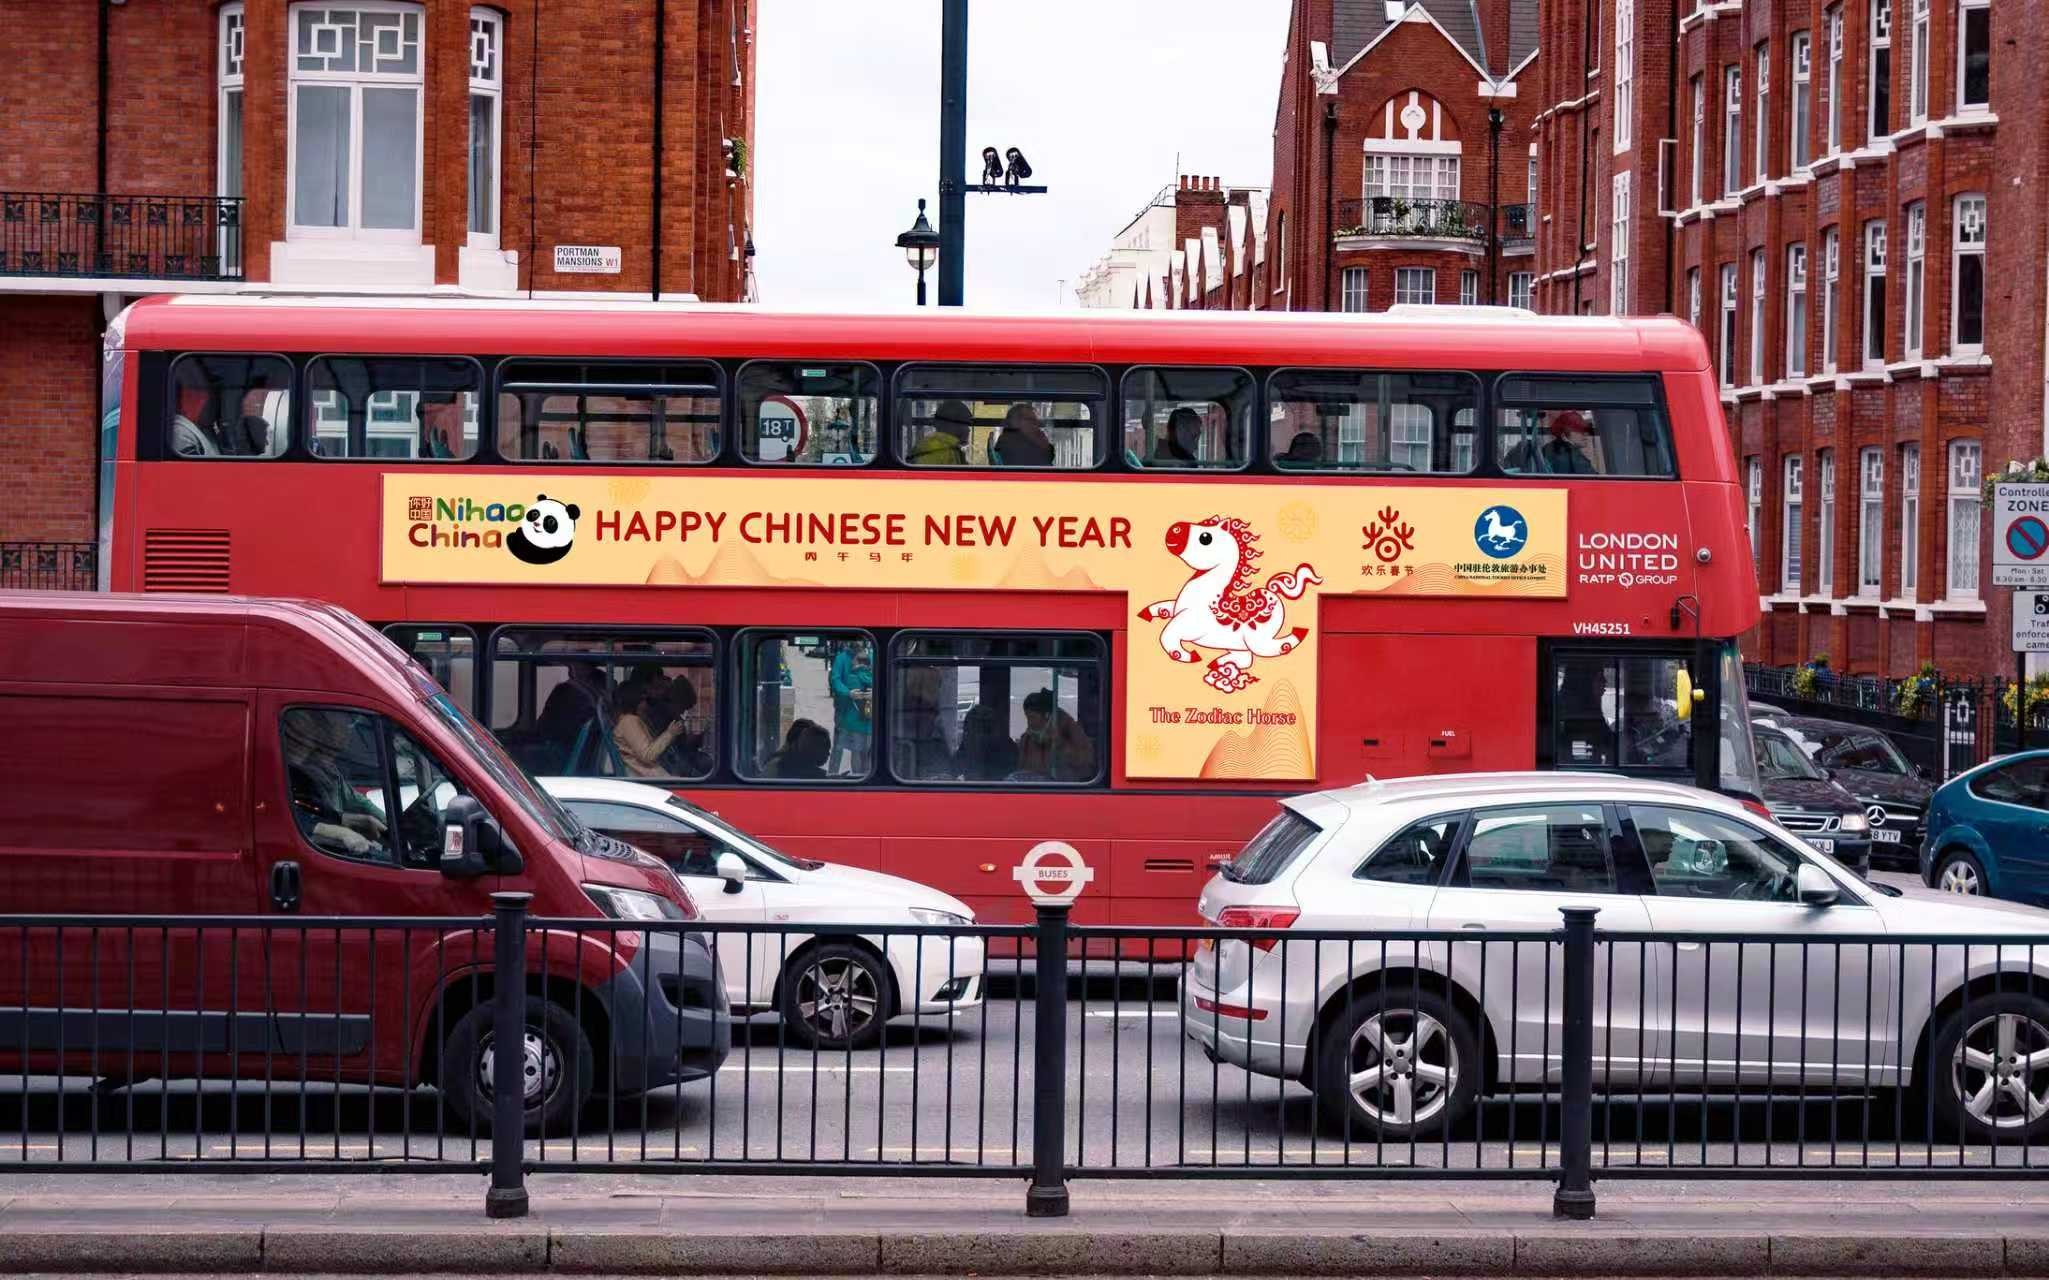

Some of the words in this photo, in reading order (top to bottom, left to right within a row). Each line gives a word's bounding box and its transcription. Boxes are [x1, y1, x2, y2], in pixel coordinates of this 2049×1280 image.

[557, 247, 600, 257] PORTMAN
[557, 257, 603, 266] MANSIONS
[606, 258, 618, 267] W1
[436, 497, 525, 522] Nihao
[2007, 500, 2049, 512] ZONE
[596, 510, 727, 542] HAPPY
[739, 512, 906, 545] CHINESE
[924, 514, 1017, 547] NEW
[1032, 516, 1132, 548] YEAR
[408, 523, 502, 548] China
[1579, 532, 1679, 550] LONDON
[1579, 554, 1679, 570] UNITED
[1361, 564, 1415, 576] 欢乐春节
[1579, 574, 1616, 584] RATP
[1635, 575, 1678, 585] GROUP
[1573, 622, 1631, 635] VH45251
[1149, 706, 1181, 724] The
[1184, 707, 1243, 725] Zodiac
[1247, 708, 1297, 725] Horse
[1881, 831, 1899, 842] YTV
[1038, 869, 1069, 878] BUSES
